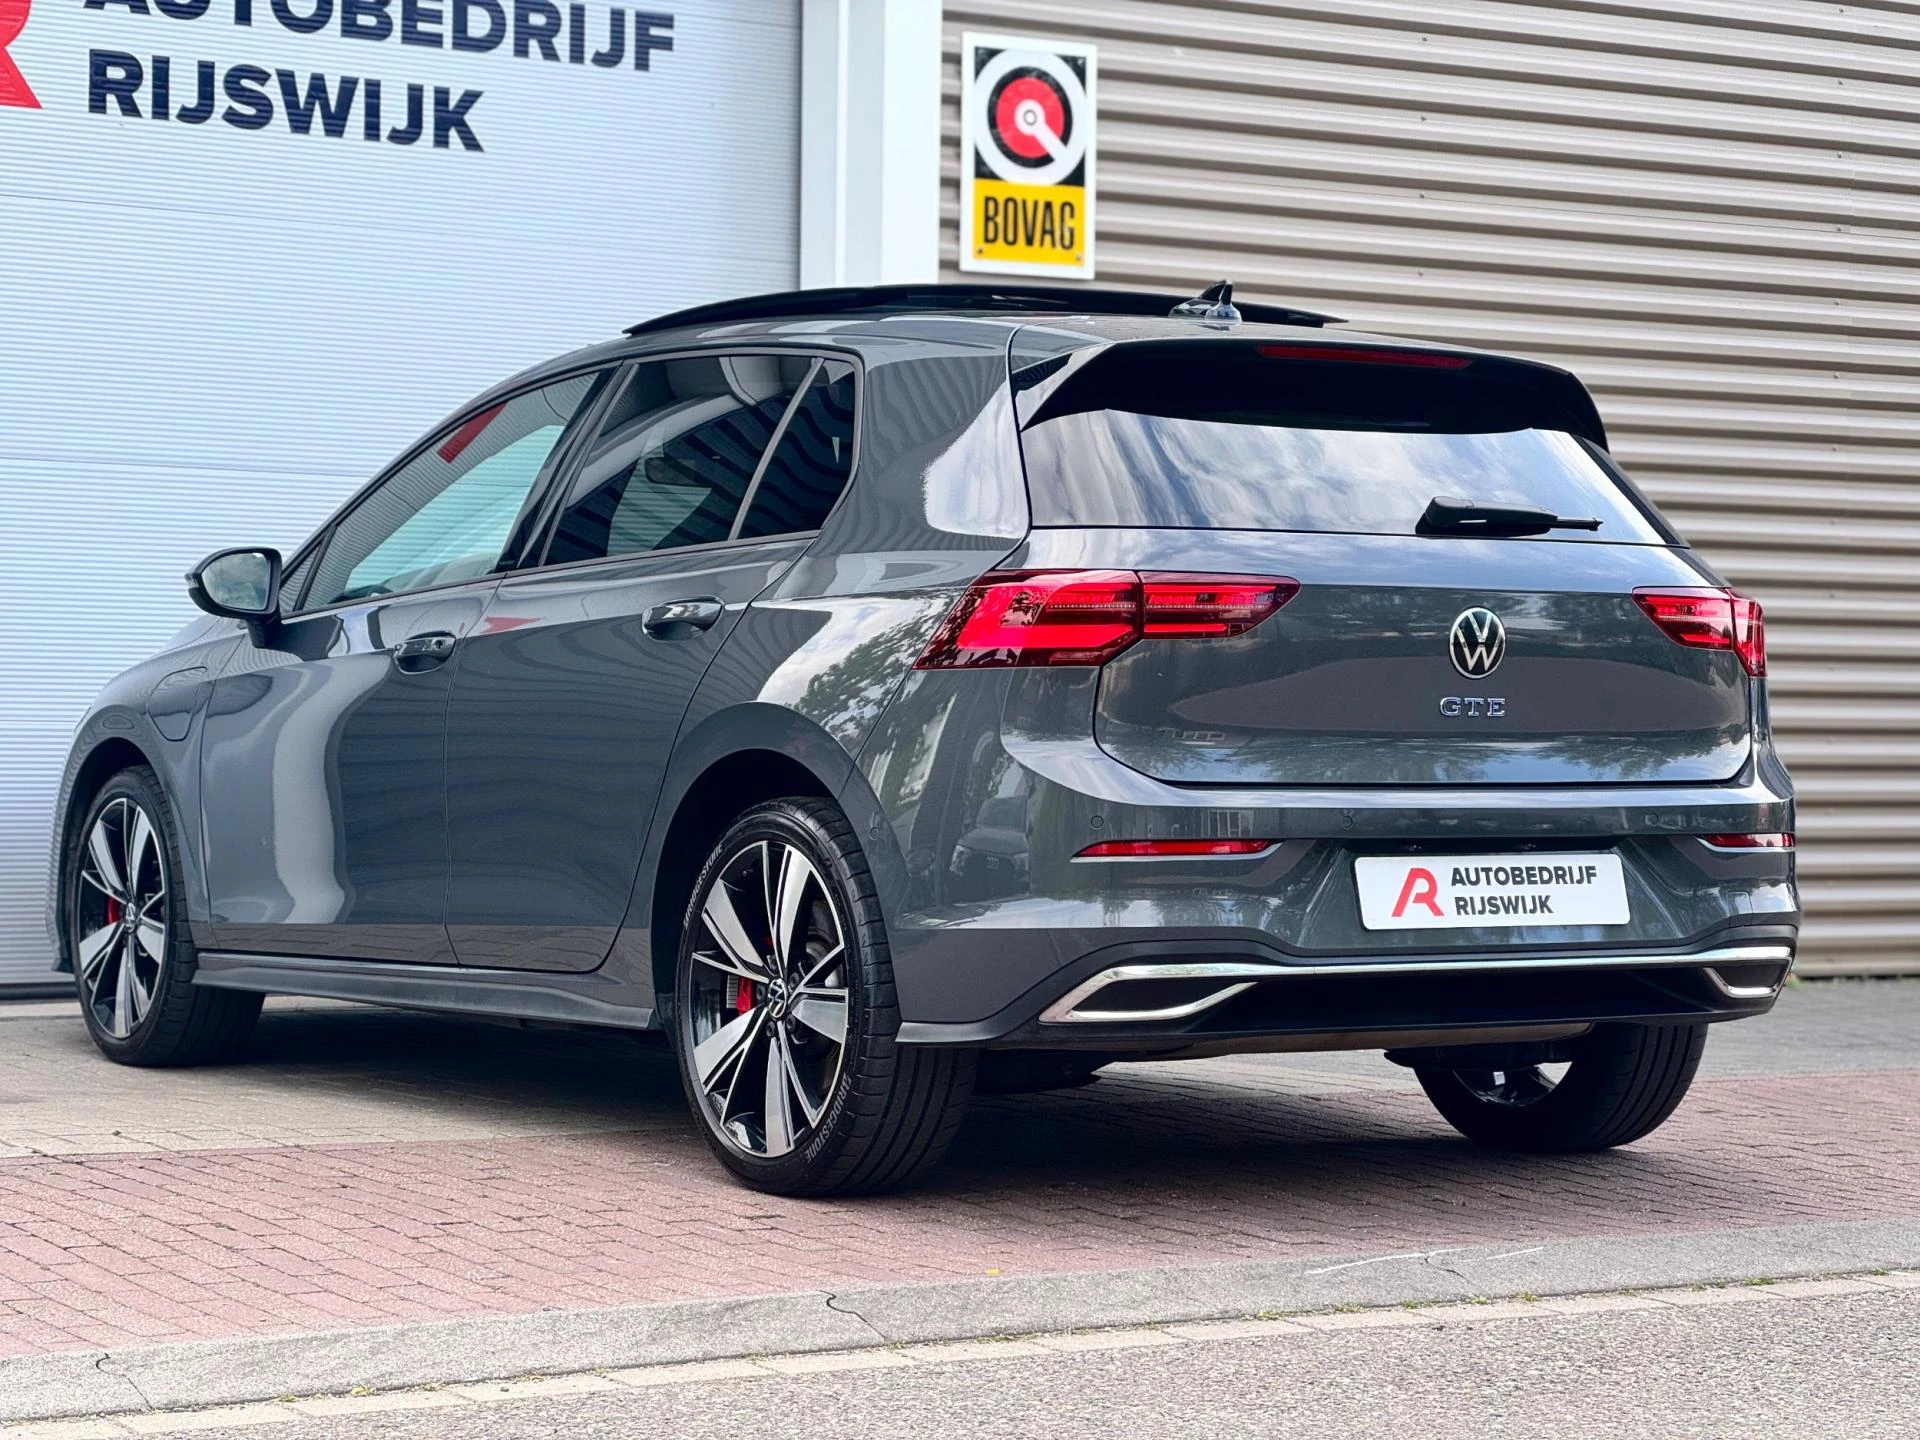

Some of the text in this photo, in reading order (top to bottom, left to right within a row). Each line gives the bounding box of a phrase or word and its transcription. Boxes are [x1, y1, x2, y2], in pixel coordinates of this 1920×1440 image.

[82, 0, 674, 72] OBEDRIJF
[88, 49, 485, 152] RIJSWIJK
[983, 196, 1074, 250] BOVAG
[1440, 696, 1505, 716] GTE
[1451, 866, 1597, 886] AUTOBEDRIJF
[1455, 895, 1553, 916] RIJSWIJK
[804, 1071, 852, 1164] BRIDGESTONE
